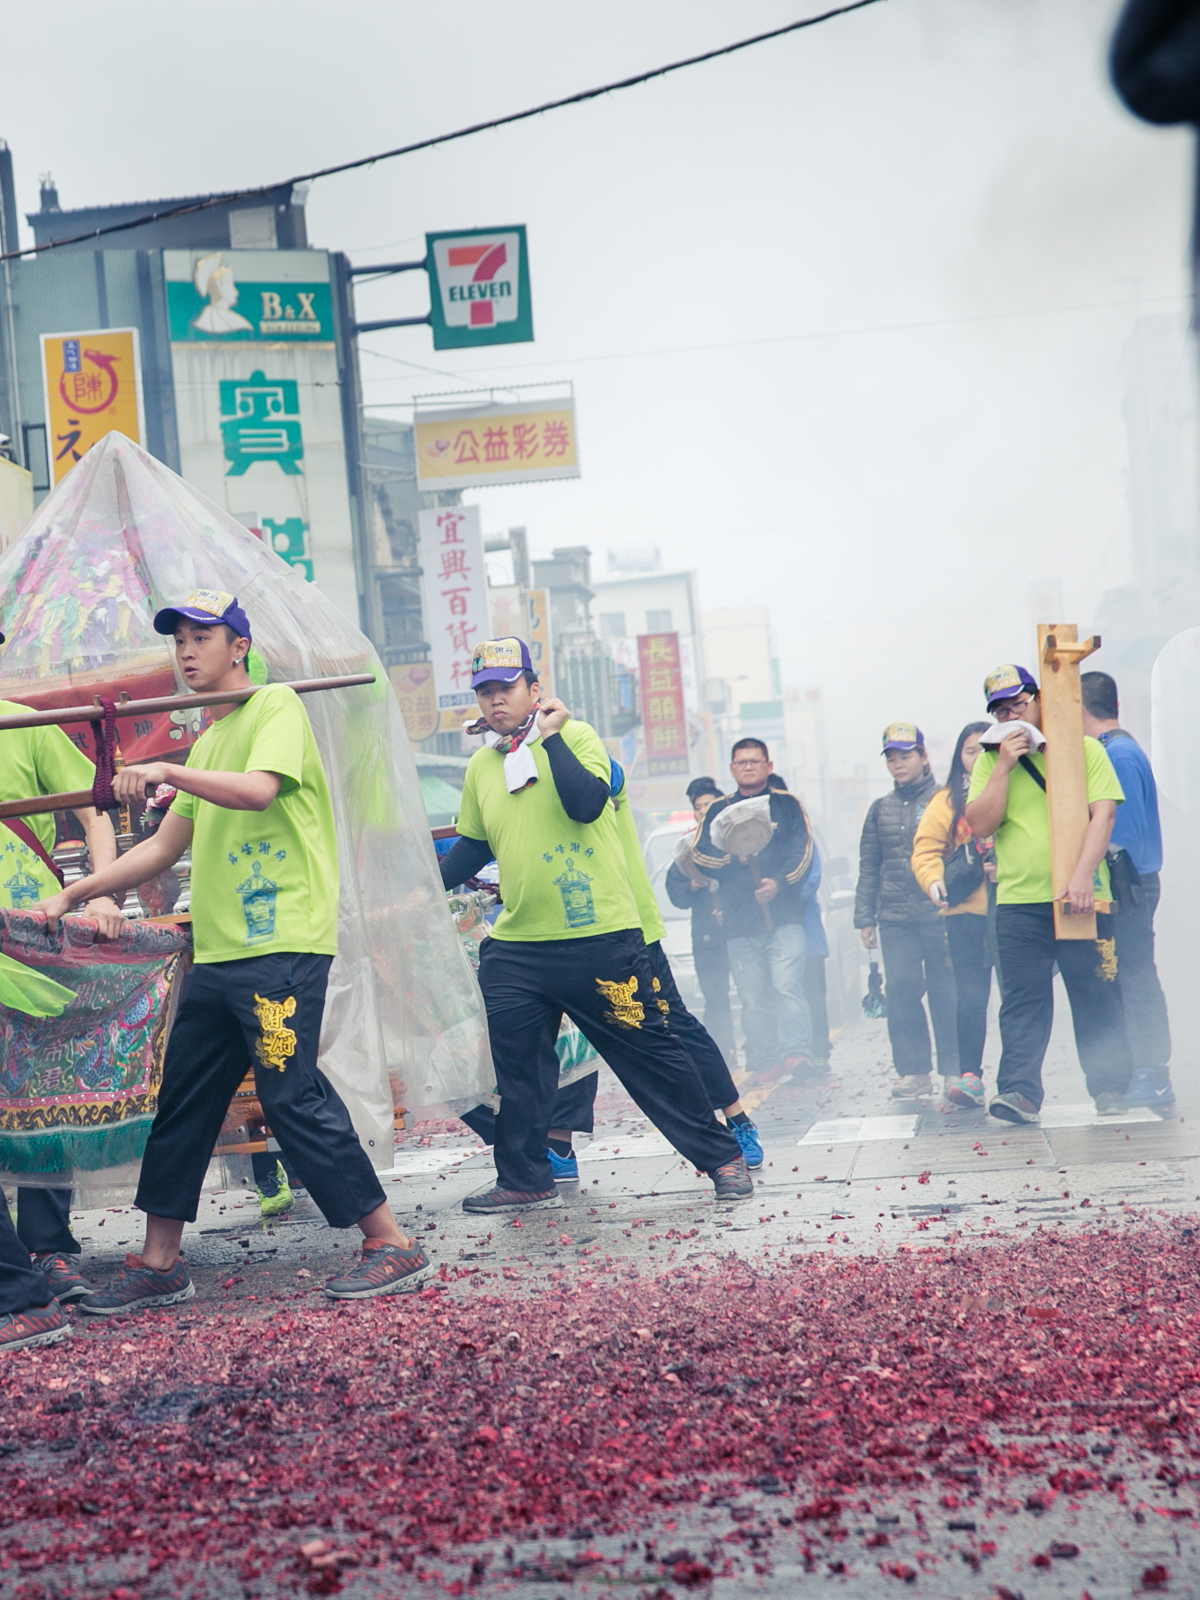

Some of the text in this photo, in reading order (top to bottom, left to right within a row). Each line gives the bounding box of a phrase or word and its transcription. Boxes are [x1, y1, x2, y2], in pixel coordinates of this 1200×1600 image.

[453, 420, 569, 464] 公益彩券
[436, 511, 478, 689] 宜興百貨行
[69, 720, 154, 750] 武神
[261, 1004, 297, 1055] 謝府
